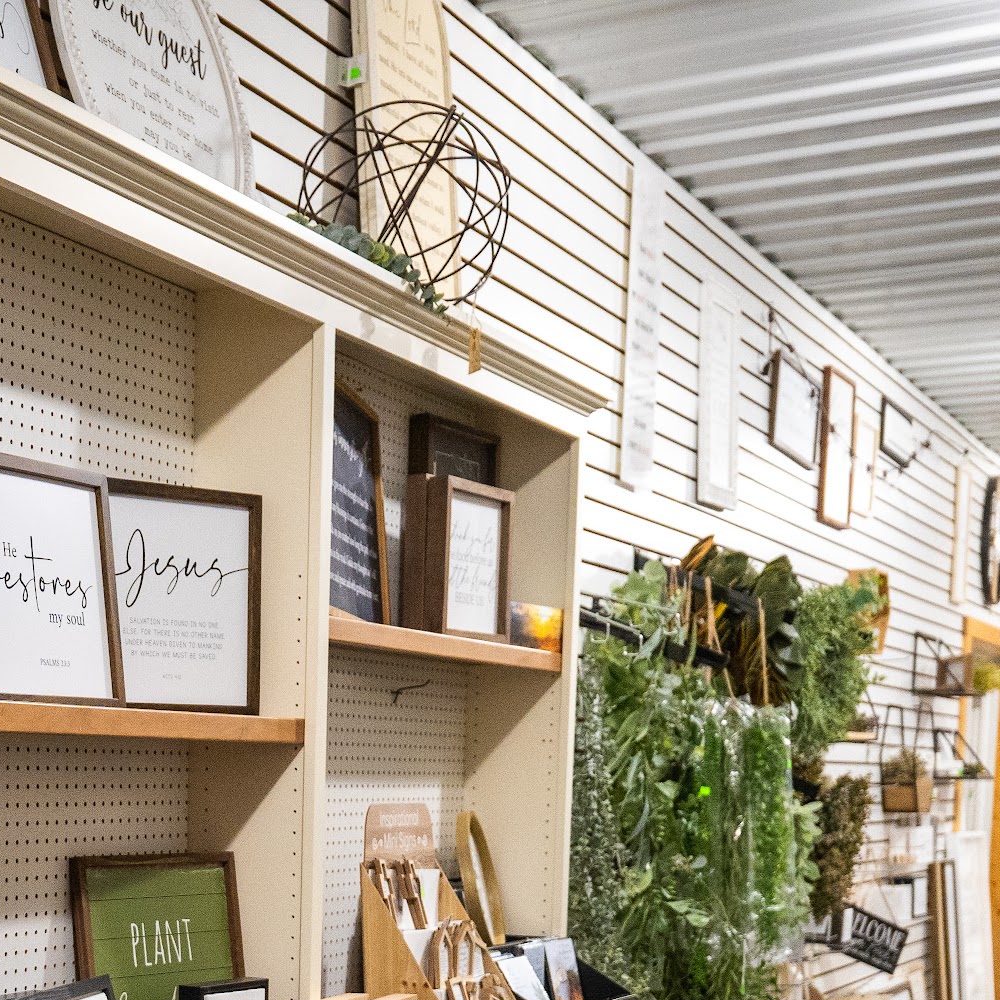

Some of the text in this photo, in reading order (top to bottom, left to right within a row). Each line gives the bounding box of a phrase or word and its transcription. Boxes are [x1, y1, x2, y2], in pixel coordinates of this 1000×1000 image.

[121, 4, 207, 80] our guest
[91, 29, 220, 118] whether you come in to visit
[129, 78, 139, 89] or
[144, 84, 161, 104] just
[164, 99, 174, 111] to
[104, 82, 127, 103] when
[130, 98, 146, 115] you
[150, 111, 173, 130] enter
[177, 127, 191, 141] our
[144, 127, 160, 145] may
[163, 138, 180, 154] you
[2, 542, 17, 558] He
[115, 529, 248, 607] Jesus
[49, 613, 86, 627] my soul
[129, 617, 160, 626] SALVATION
[163, 618, 169, 626] IS
[154, 629, 171, 637] THERE
[125, 638, 143, 646] UNDER
[145, 639, 167, 647] HEAVEN
[189, 641, 195, 649] TO
[40, 658, 59, 667] PSALMS
[130, 918, 195, 967] PLANT
